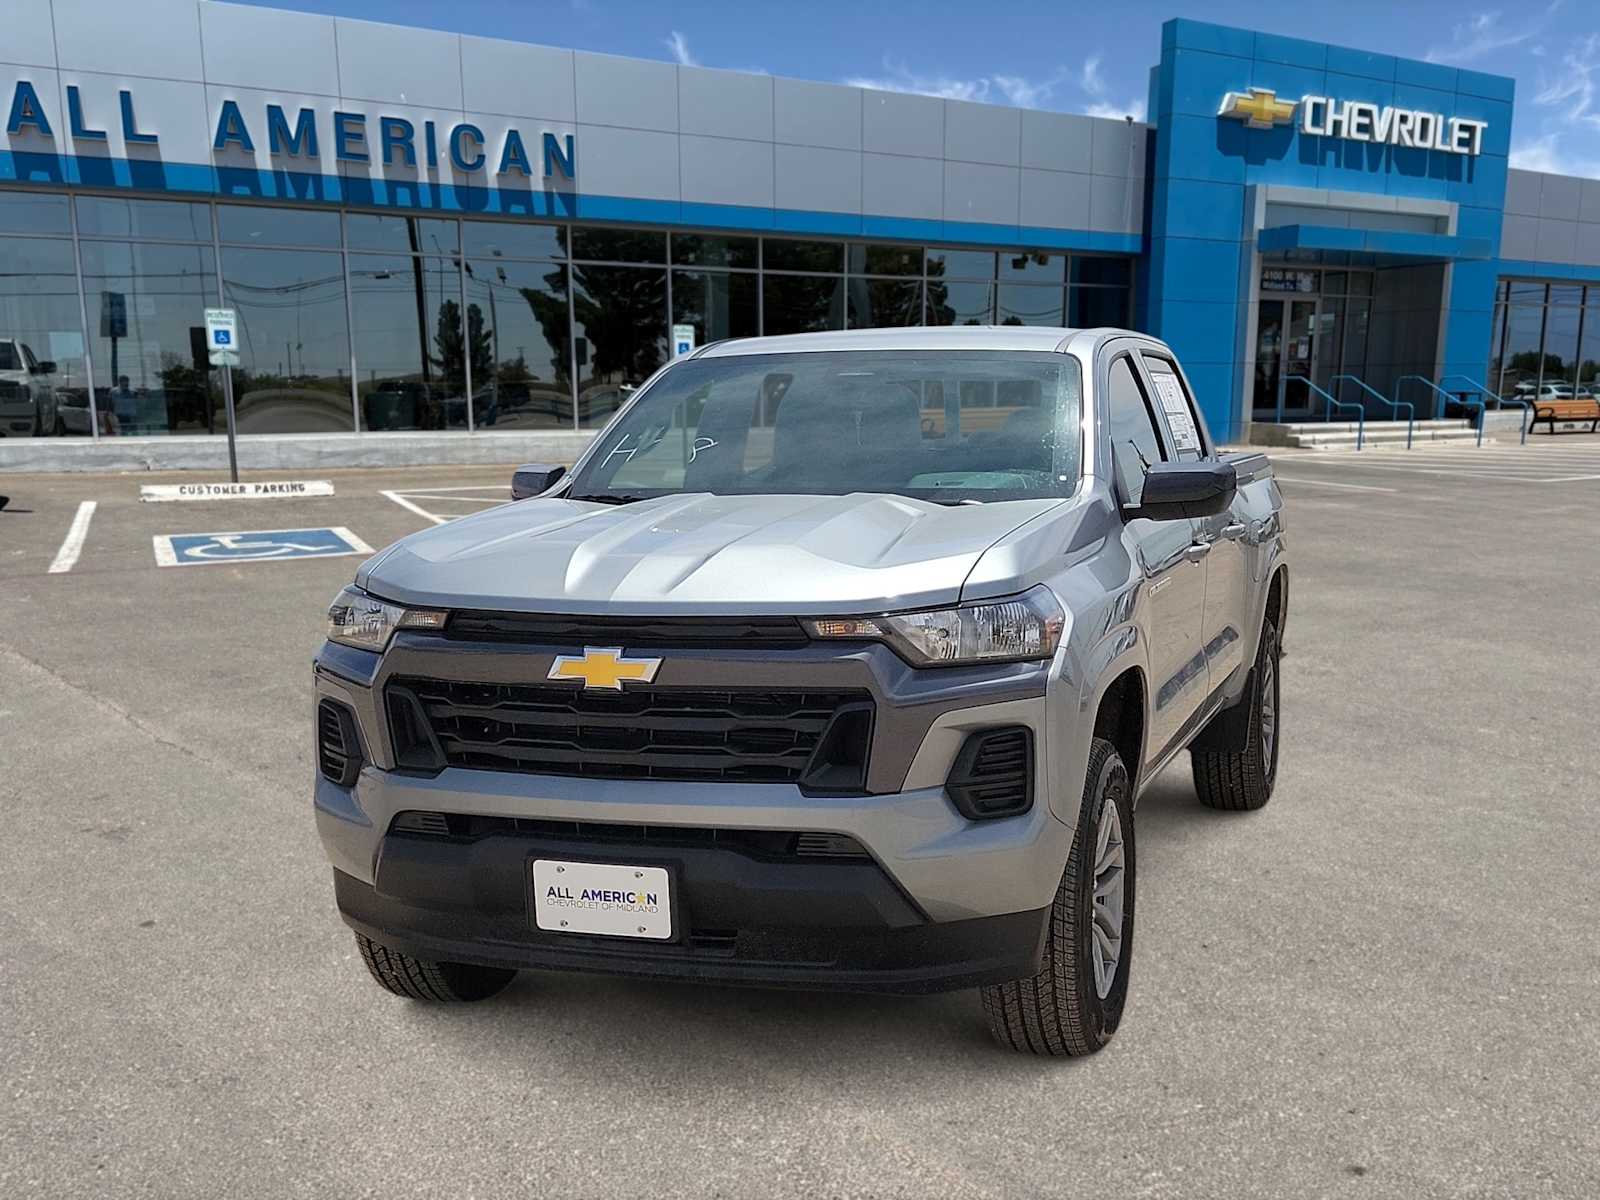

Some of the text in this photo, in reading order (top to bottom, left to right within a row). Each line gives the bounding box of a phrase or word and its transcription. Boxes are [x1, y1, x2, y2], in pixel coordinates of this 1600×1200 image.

[7, 81, 576, 179] ALL AMERICAN
[1301, 94, 1488, 156] CHEVROLET
[179, 483, 305, 495] CUSTOMER PARKING
[547, 886, 574, 900] ALL
[547, 898, 659, 914] CHEVROLET OF MIDLAND
